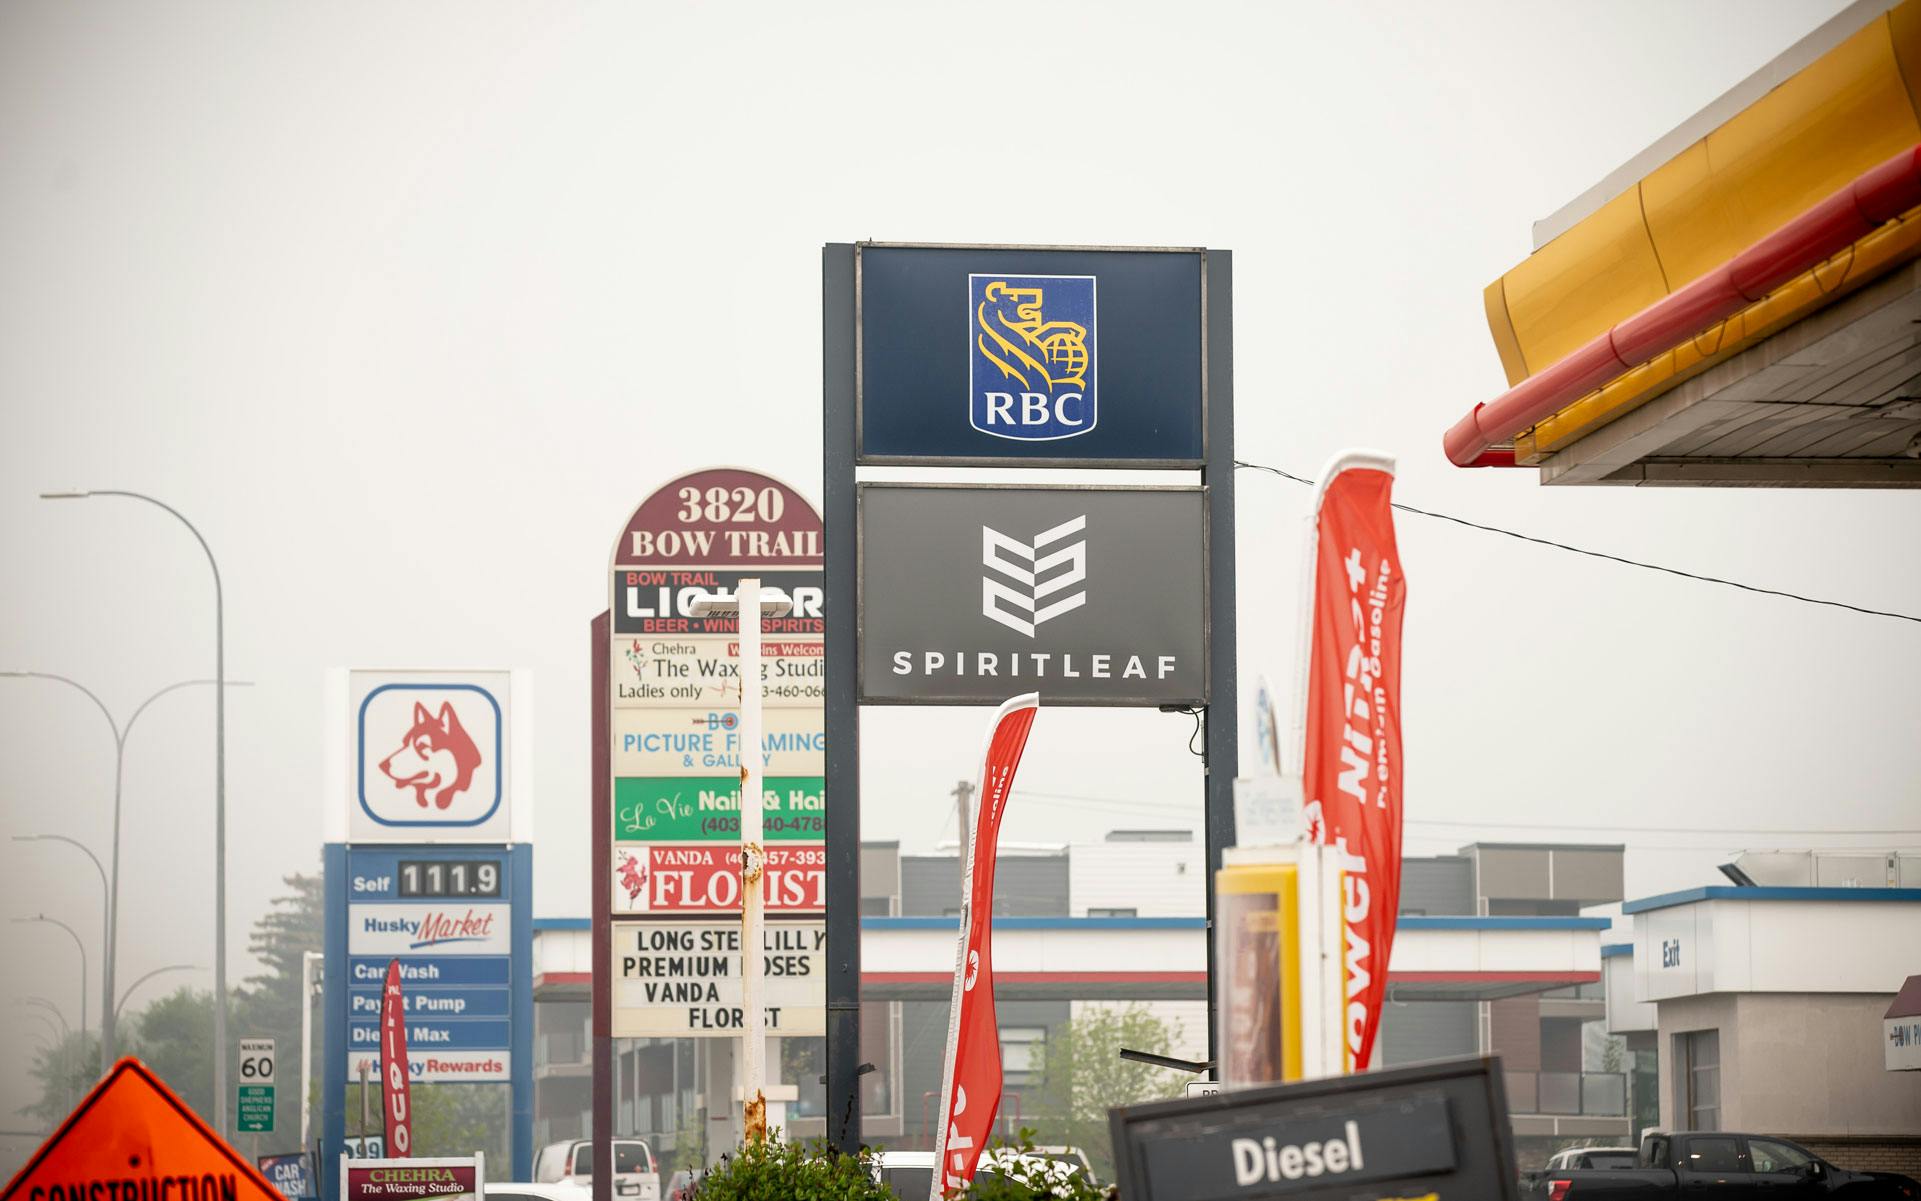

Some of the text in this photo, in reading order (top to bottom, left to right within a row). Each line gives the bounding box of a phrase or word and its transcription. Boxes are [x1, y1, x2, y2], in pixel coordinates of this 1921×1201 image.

[983, 392, 1084, 427] RBC
[678, 487, 785, 523] 3820
[631, 531, 824, 557] BOW TRAIL
[626, 572, 719, 585] BOW TRAIL
[644, 619, 825, 633] BEER WIN SPIRITS
[652, 642, 696, 655] Chehra
[652, 658, 824, 680] The Waxg Studi
[892, 650, 1177, 680] SPIRITLEAF
[619, 684, 667, 698] Ladies
[670, 685, 702, 700] only
[708, 713, 739, 731] BO
[624, 734, 713, 752] PICTURE
[683, 754, 772, 767] & GALLY
[698, 790, 825, 810] Nail & Hai
[620, 793, 694, 833] La Vie
[653, 851, 714, 865] VANDA
[353, 864, 497, 892] Self 111.9
[364, 909, 493, 946] Husky Market
[638, 931, 694, 951] LONG
[701, 931, 743, 951] STE
[1662, 938, 1680, 968] Exit
[354, 964, 387, 979] Car
[623, 956, 810, 977] PREMIUM OSES
[645, 982, 720, 1002] VANDA
[353, 996, 382, 1014] Pay
[415, 996, 466, 1013] Pump
[413, 1028, 451, 1042] Max
[241, 1057, 273, 1077] 60
[426, 1059, 503, 1073] Rewards
[387, 999, 409, 1159] LIQUO
[1231, 1120, 1365, 1186] Diesel
[274, 1163, 300, 1180] CAR
[369, 1168, 456, 1182] CHEHRA
[361, 1182, 465, 1195] The Waxing Studio
